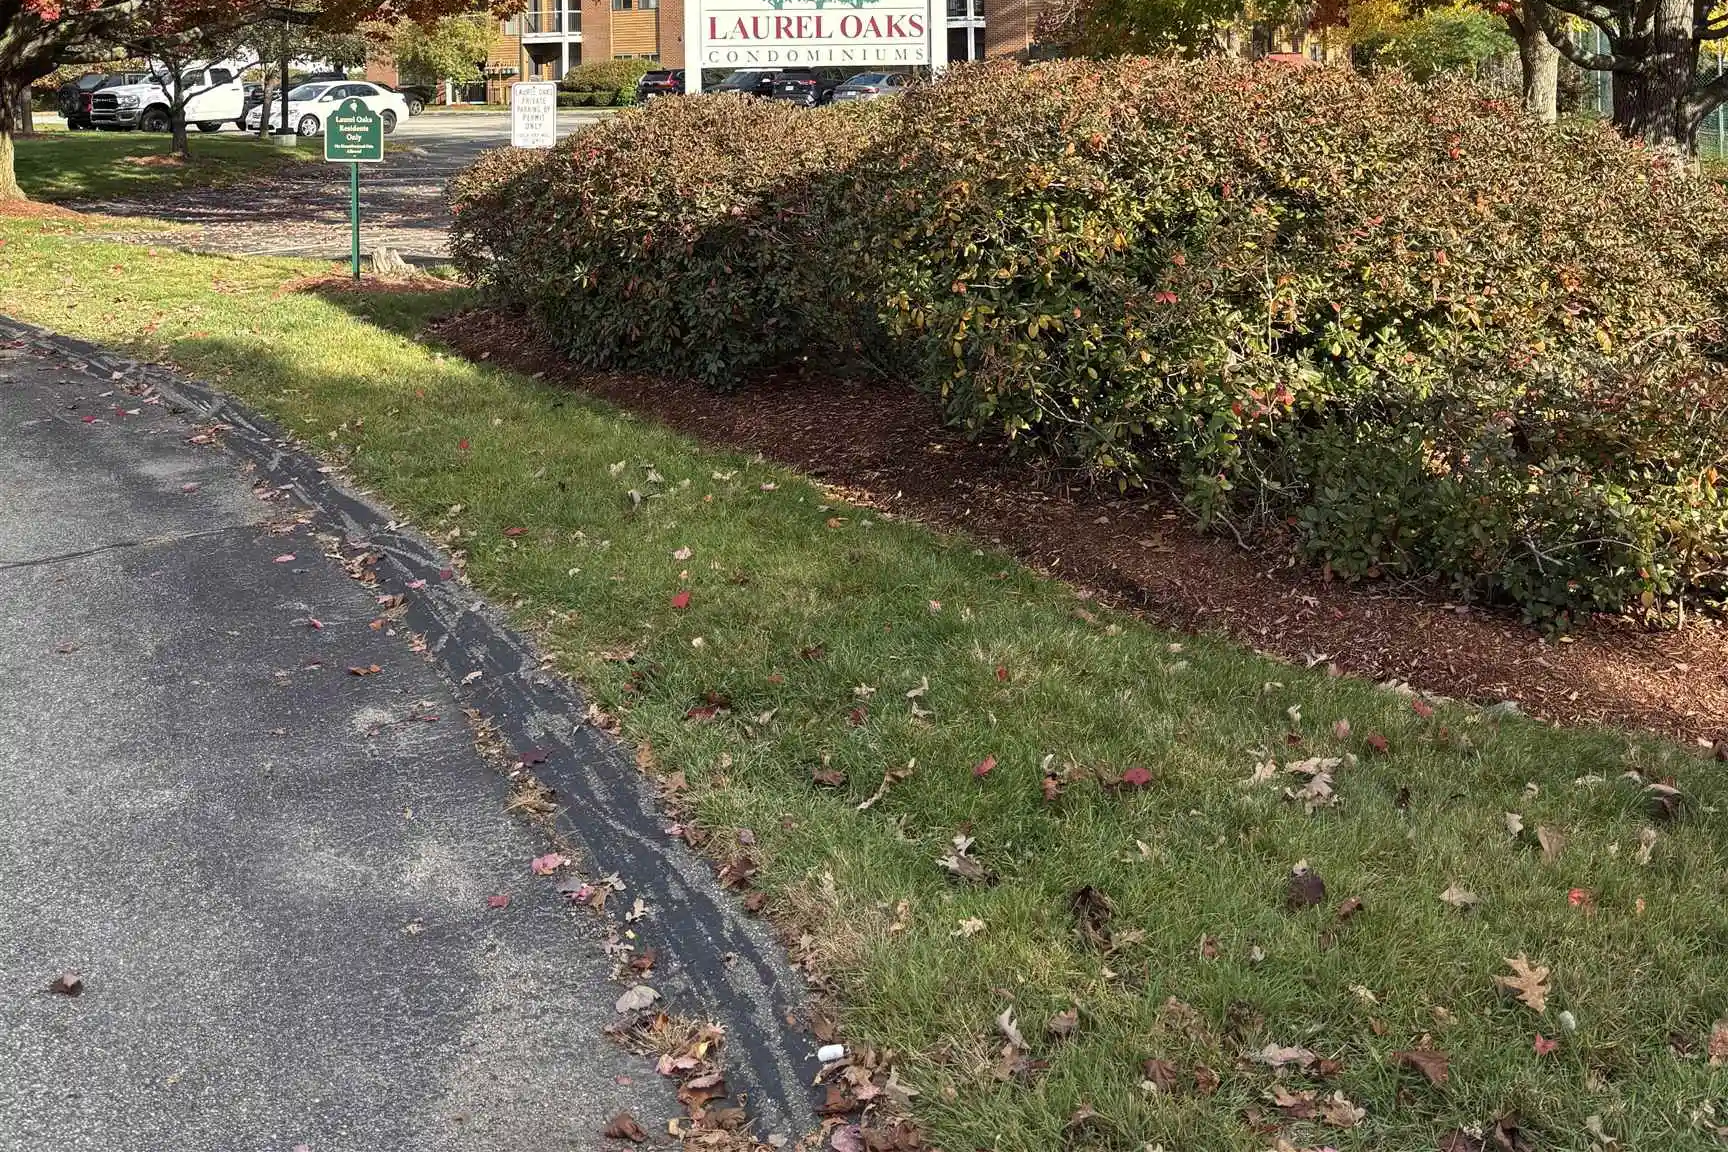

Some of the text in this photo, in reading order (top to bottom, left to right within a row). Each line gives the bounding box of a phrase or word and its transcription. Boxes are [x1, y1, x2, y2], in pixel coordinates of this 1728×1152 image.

[709, 14, 924, 40] LAUREL OAKS
[708, 48, 924, 63] CONDOMINIUMS
[522, 113, 544, 121] PERMIT
[339, 124, 369, 132] Residents
[524, 122, 542, 130] ONLY
[346, 133, 362, 142] Only
